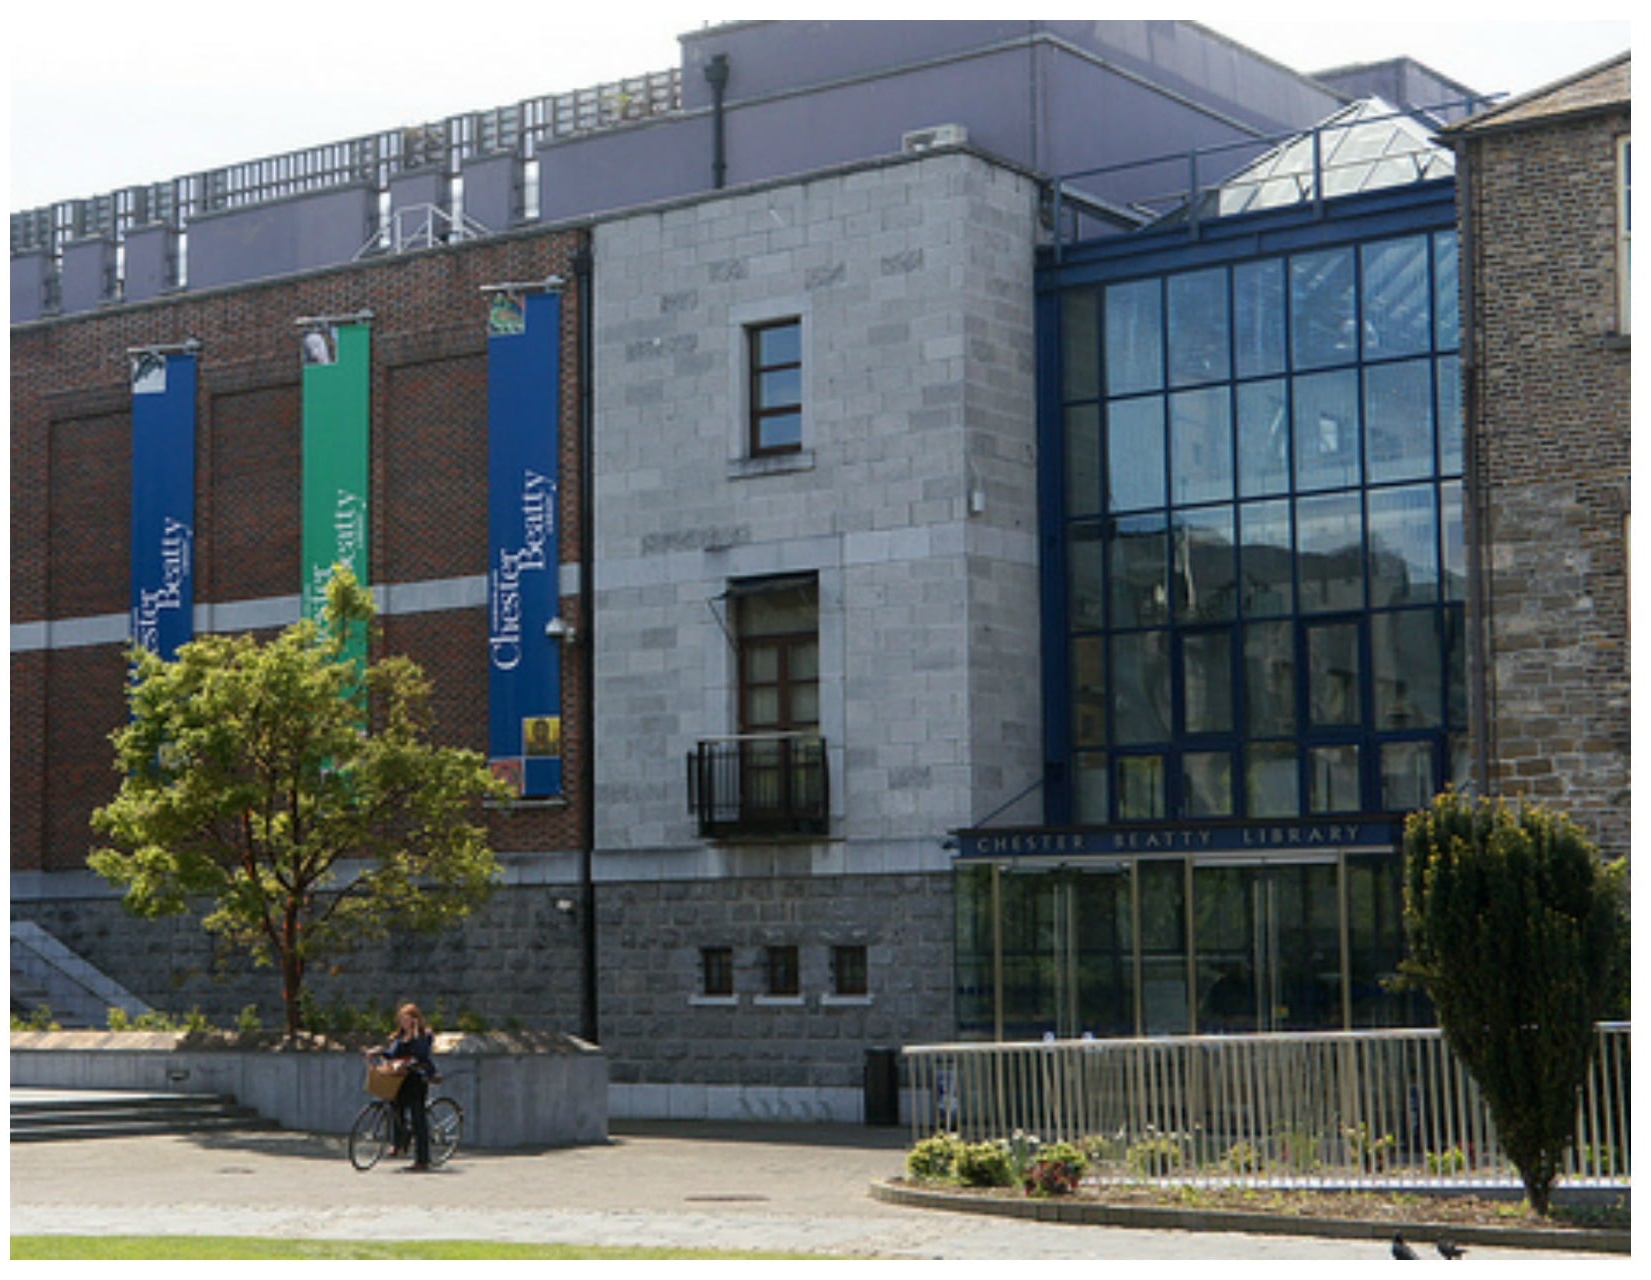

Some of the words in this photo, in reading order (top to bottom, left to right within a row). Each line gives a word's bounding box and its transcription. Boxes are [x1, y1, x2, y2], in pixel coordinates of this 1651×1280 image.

[155, 517, 193, 608] Beatty
[335, 488, 367, 570] eatty
[519, 469, 557, 569] Beatty
[489, 547, 522, 670] Chester
[977, 833, 1085, 851] CHESTER
[1114, 829, 1210, 847] BEATTY
[1243, 824, 1359, 843] LIBRARY
